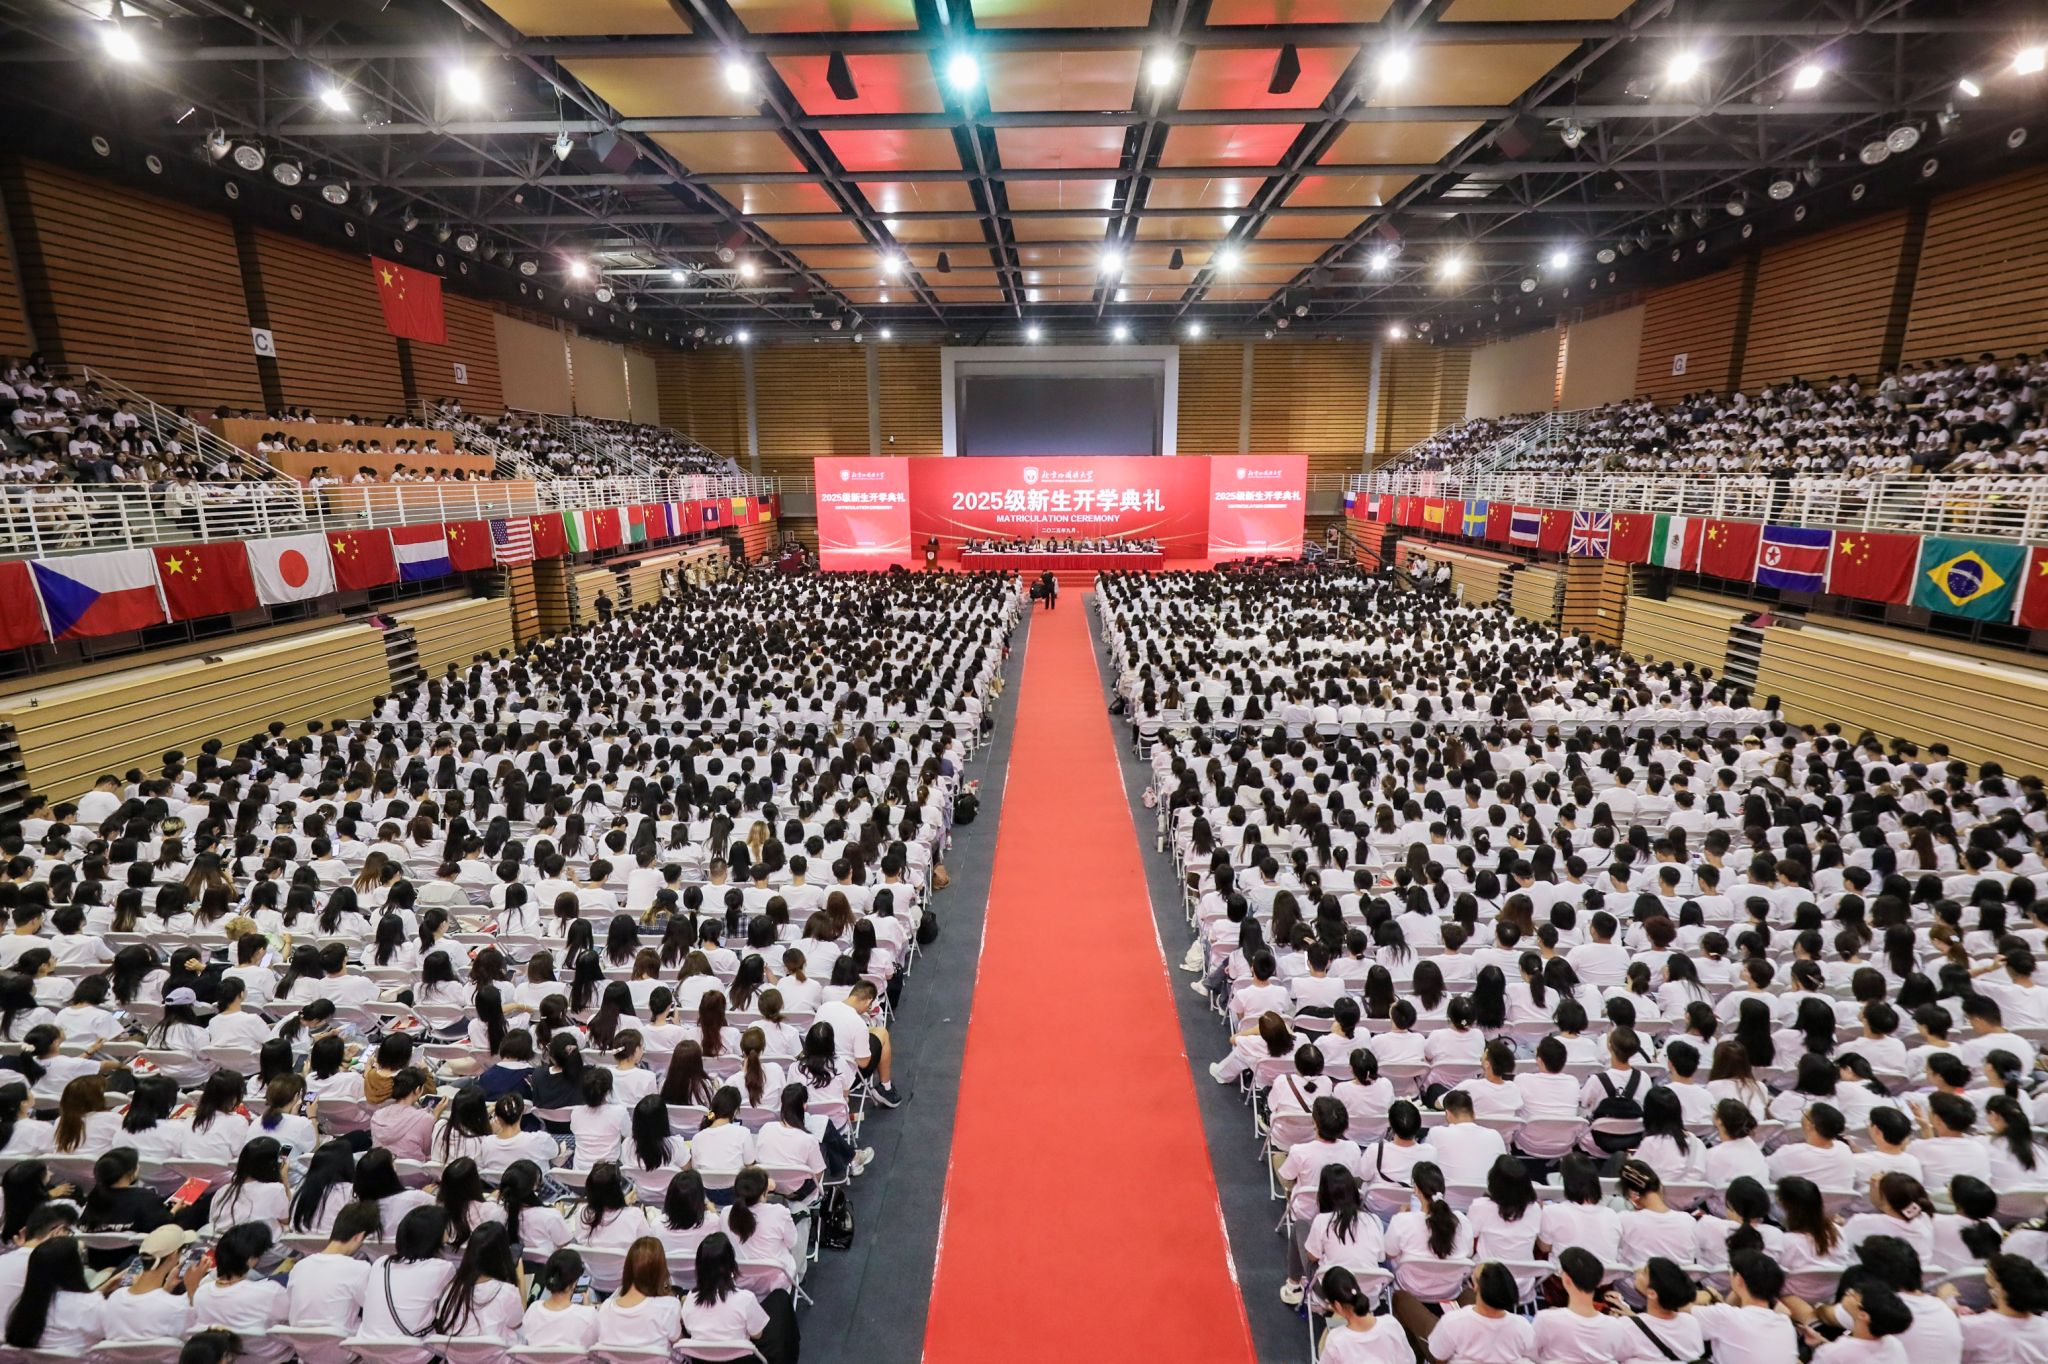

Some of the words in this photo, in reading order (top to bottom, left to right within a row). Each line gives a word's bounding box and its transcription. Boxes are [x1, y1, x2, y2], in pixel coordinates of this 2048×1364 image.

[255, 333, 268, 350] C
[1674, 358, 1683, 371] G
[456, 367, 463, 380] D
[952, 488, 1166, 512] 2025级新生开学典礼
[996, 514, 1069, 523] MATRICULATION
[1070, 514, 1121, 523] CEREMONY
